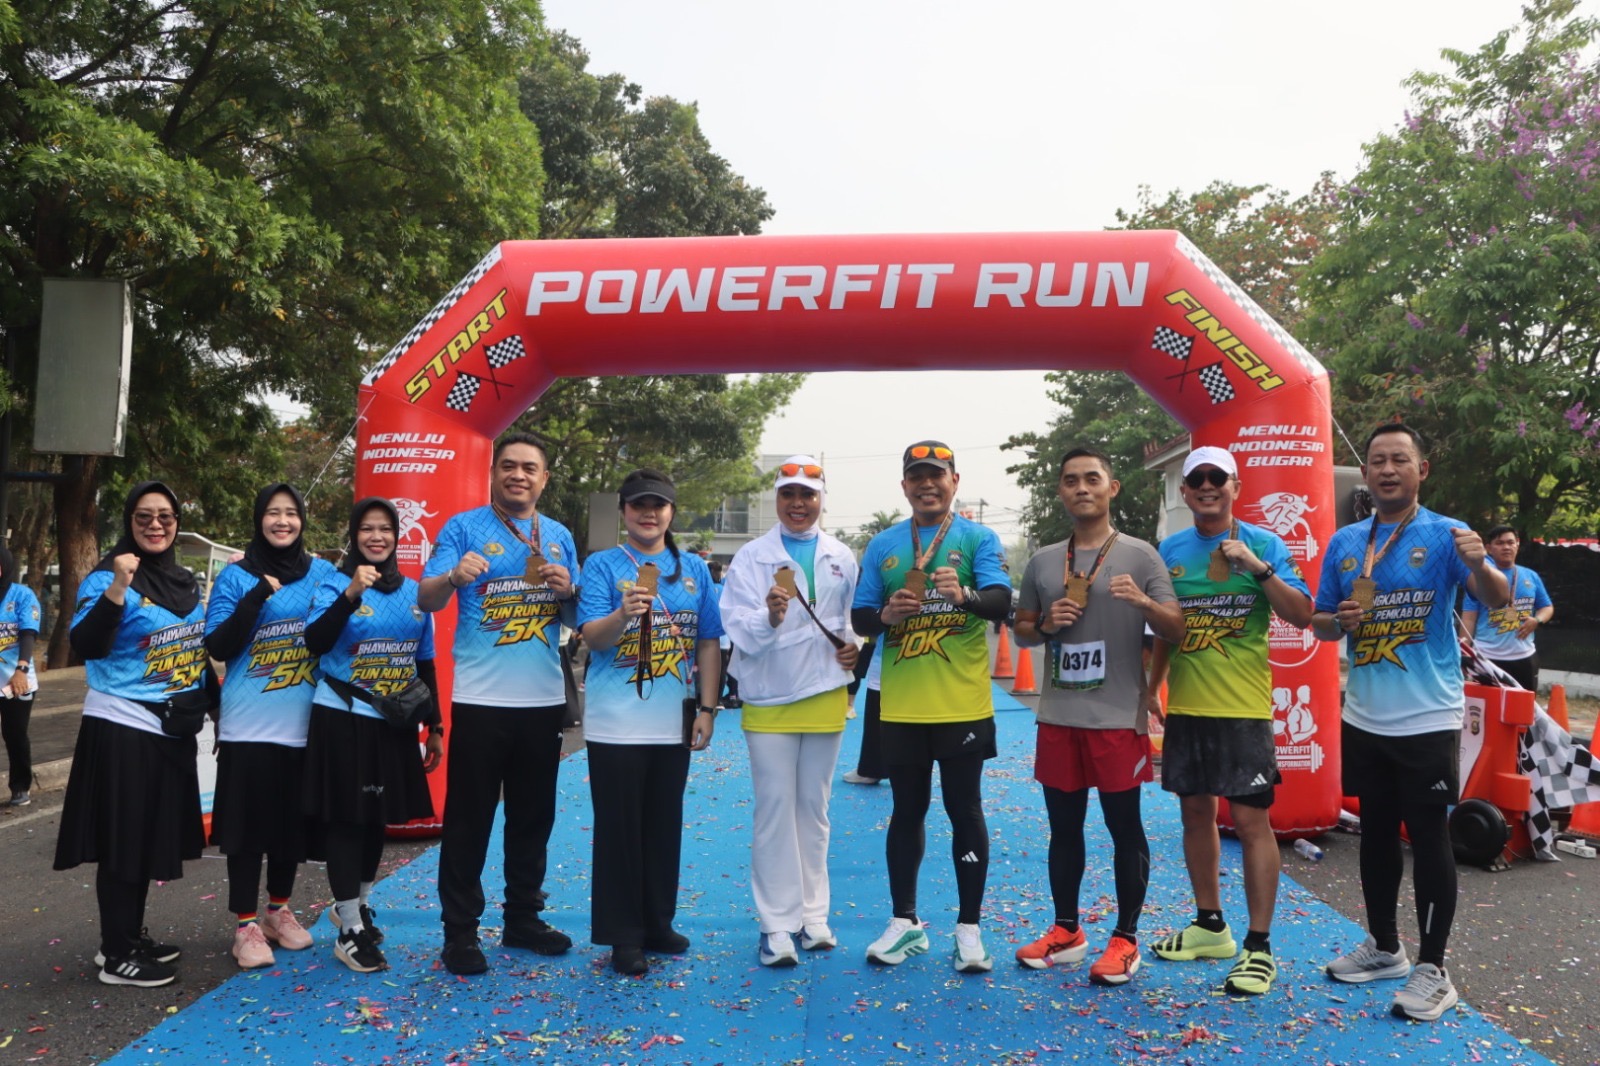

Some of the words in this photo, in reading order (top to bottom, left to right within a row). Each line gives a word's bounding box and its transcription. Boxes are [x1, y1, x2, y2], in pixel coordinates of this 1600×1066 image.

[524, 263, 955, 316] POWERFIT
[973, 262, 1150, 308] RUN
[403, 288, 508, 404] START
[1164, 288, 1286, 392] FINISH
[369, 432, 446, 445] MENUJU
[1238, 424, 1318, 437] MENUJU
[362, 447, 456, 461] INDONESIA
[1227, 440, 1325, 453] INDONESIA
[372, 462, 438, 474] BUGAR
[1245, 455, 1314, 467] BUGAR
[480, 605, 514, 625] FUN
[512, 603, 541, 618] RUN
[1185, 615, 1215, 628] RUN
[1375, 607, 1413, 620] PEMKAB
[906, 615, 934, 631] RUN
[1361, 621, 1392, 638] RUN
[493, 617, 551, 648] 5K
[614, 641, 640, 662] FU
[893, 627, 952, 667] 10K
[1353, 634, 1408, 672] 5K
[247, 650, 282, 673] FUN
[1062, 649, 1102, 671] 0374
[261, 659, 320, 694] 5K
[350, 668, 380, 683] FUN
[380, 667, 403, 680] RUN
[1274, 745, 1311, 755] OWERFIT
